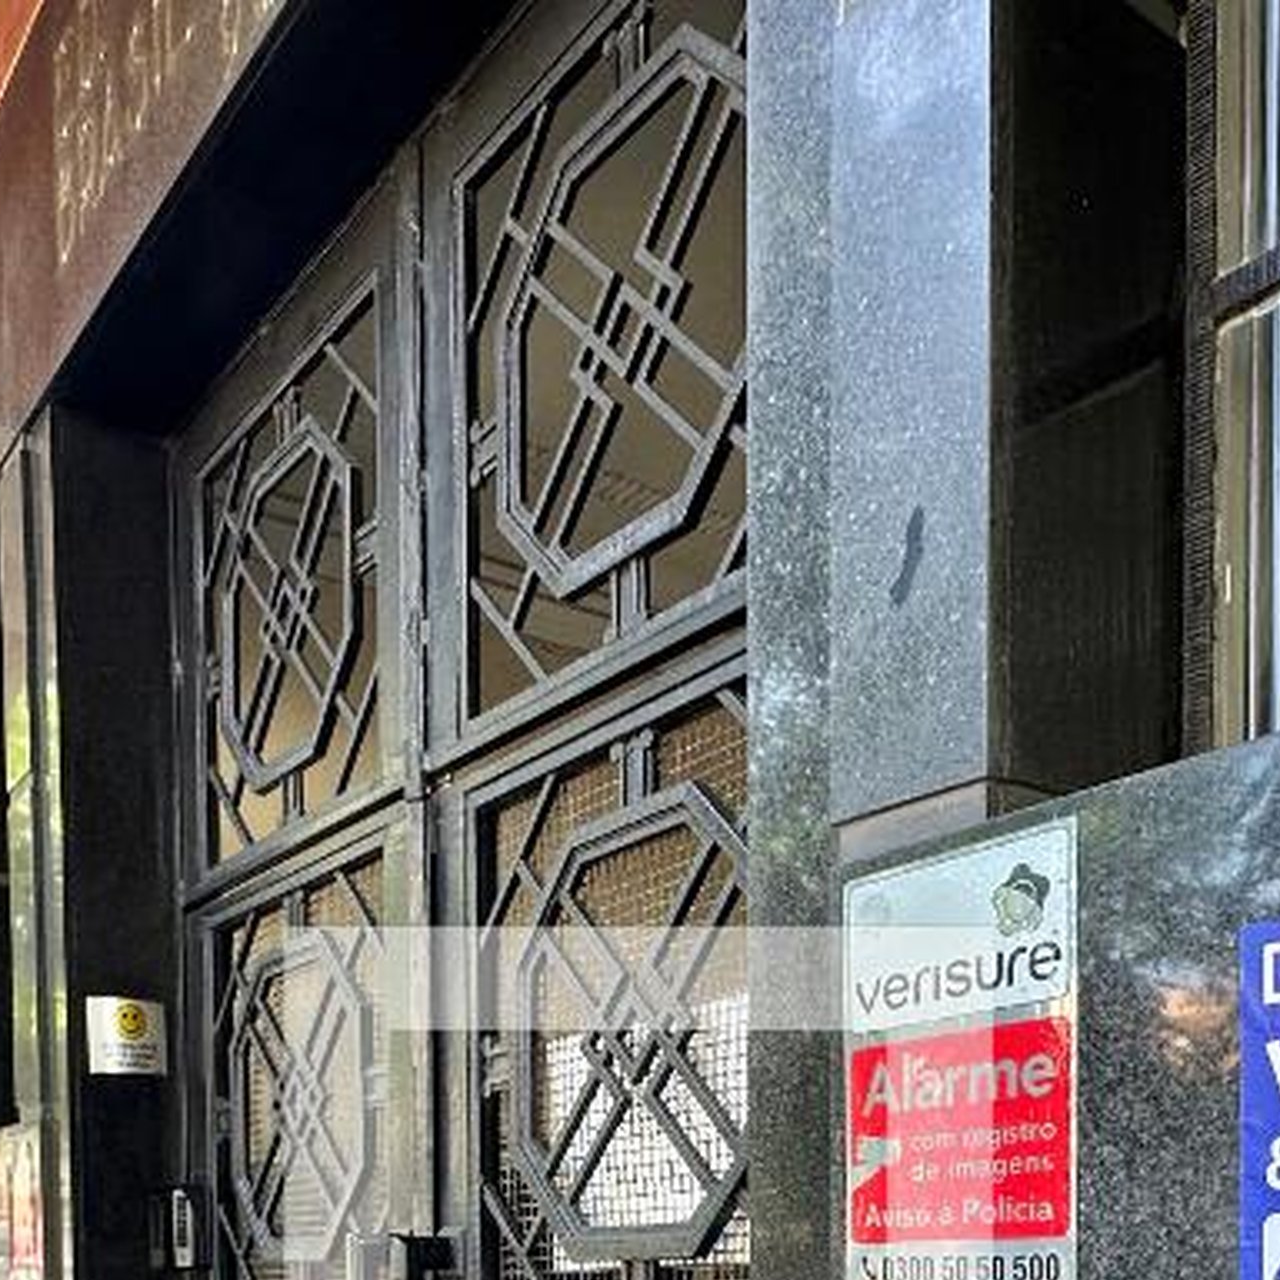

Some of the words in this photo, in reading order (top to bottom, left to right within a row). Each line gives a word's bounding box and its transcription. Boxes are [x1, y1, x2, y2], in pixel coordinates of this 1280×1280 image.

[856, 941, 1062, 1015] verisure
[861, 1051, 1057, 1119] Alarme
[909, 1130, 957, 1151] com
[910, 1159, 939, 1182] de
[949, 1152, 1055, 1184] imagens
[865, 1201, 932, 1229] Aviso
